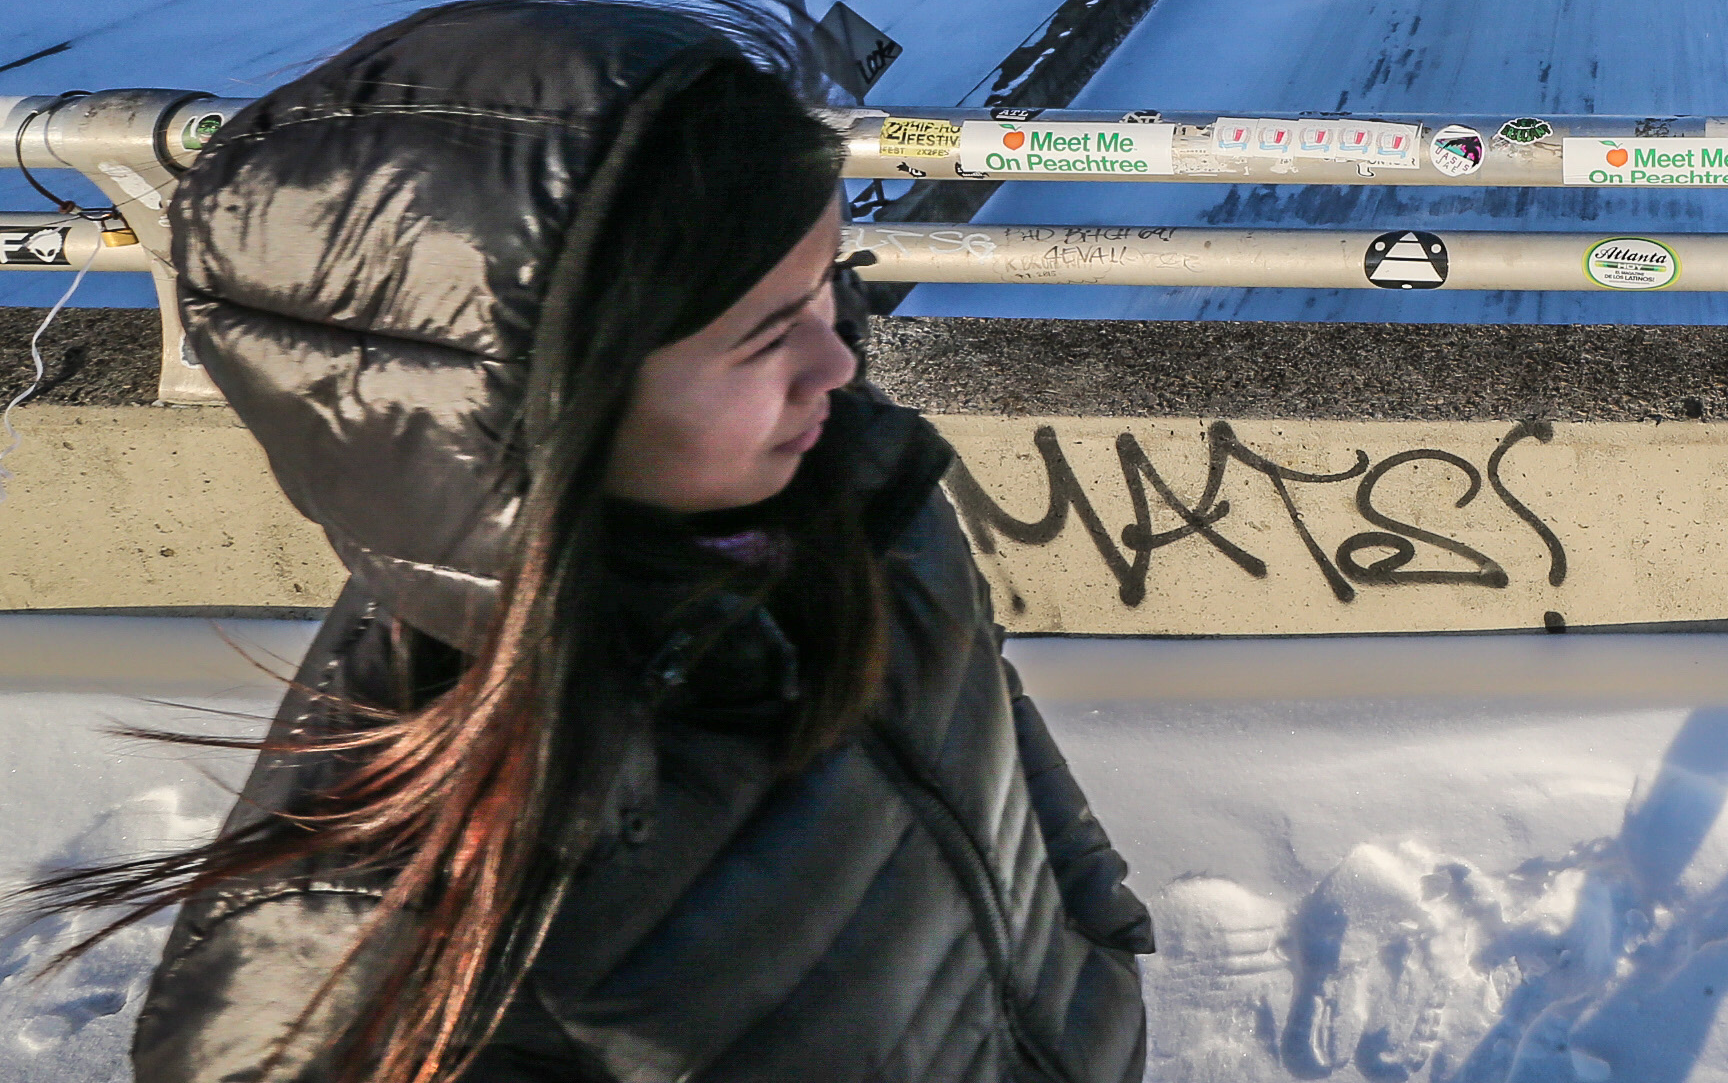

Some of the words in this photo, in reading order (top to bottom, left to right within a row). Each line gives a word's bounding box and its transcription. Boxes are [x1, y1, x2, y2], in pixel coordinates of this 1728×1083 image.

[1030, 131, 1091, 153] Meet
[1096, 132, 1134, 153] Me
[985, 153, 1020, 172] On
[1027, 154, 1149, 173] Peachtree
[1634, 148, 1695, 168] Meet
[1588, 170, 1623, 184] On
[1594, 247, 1667, 264] Atlanta
